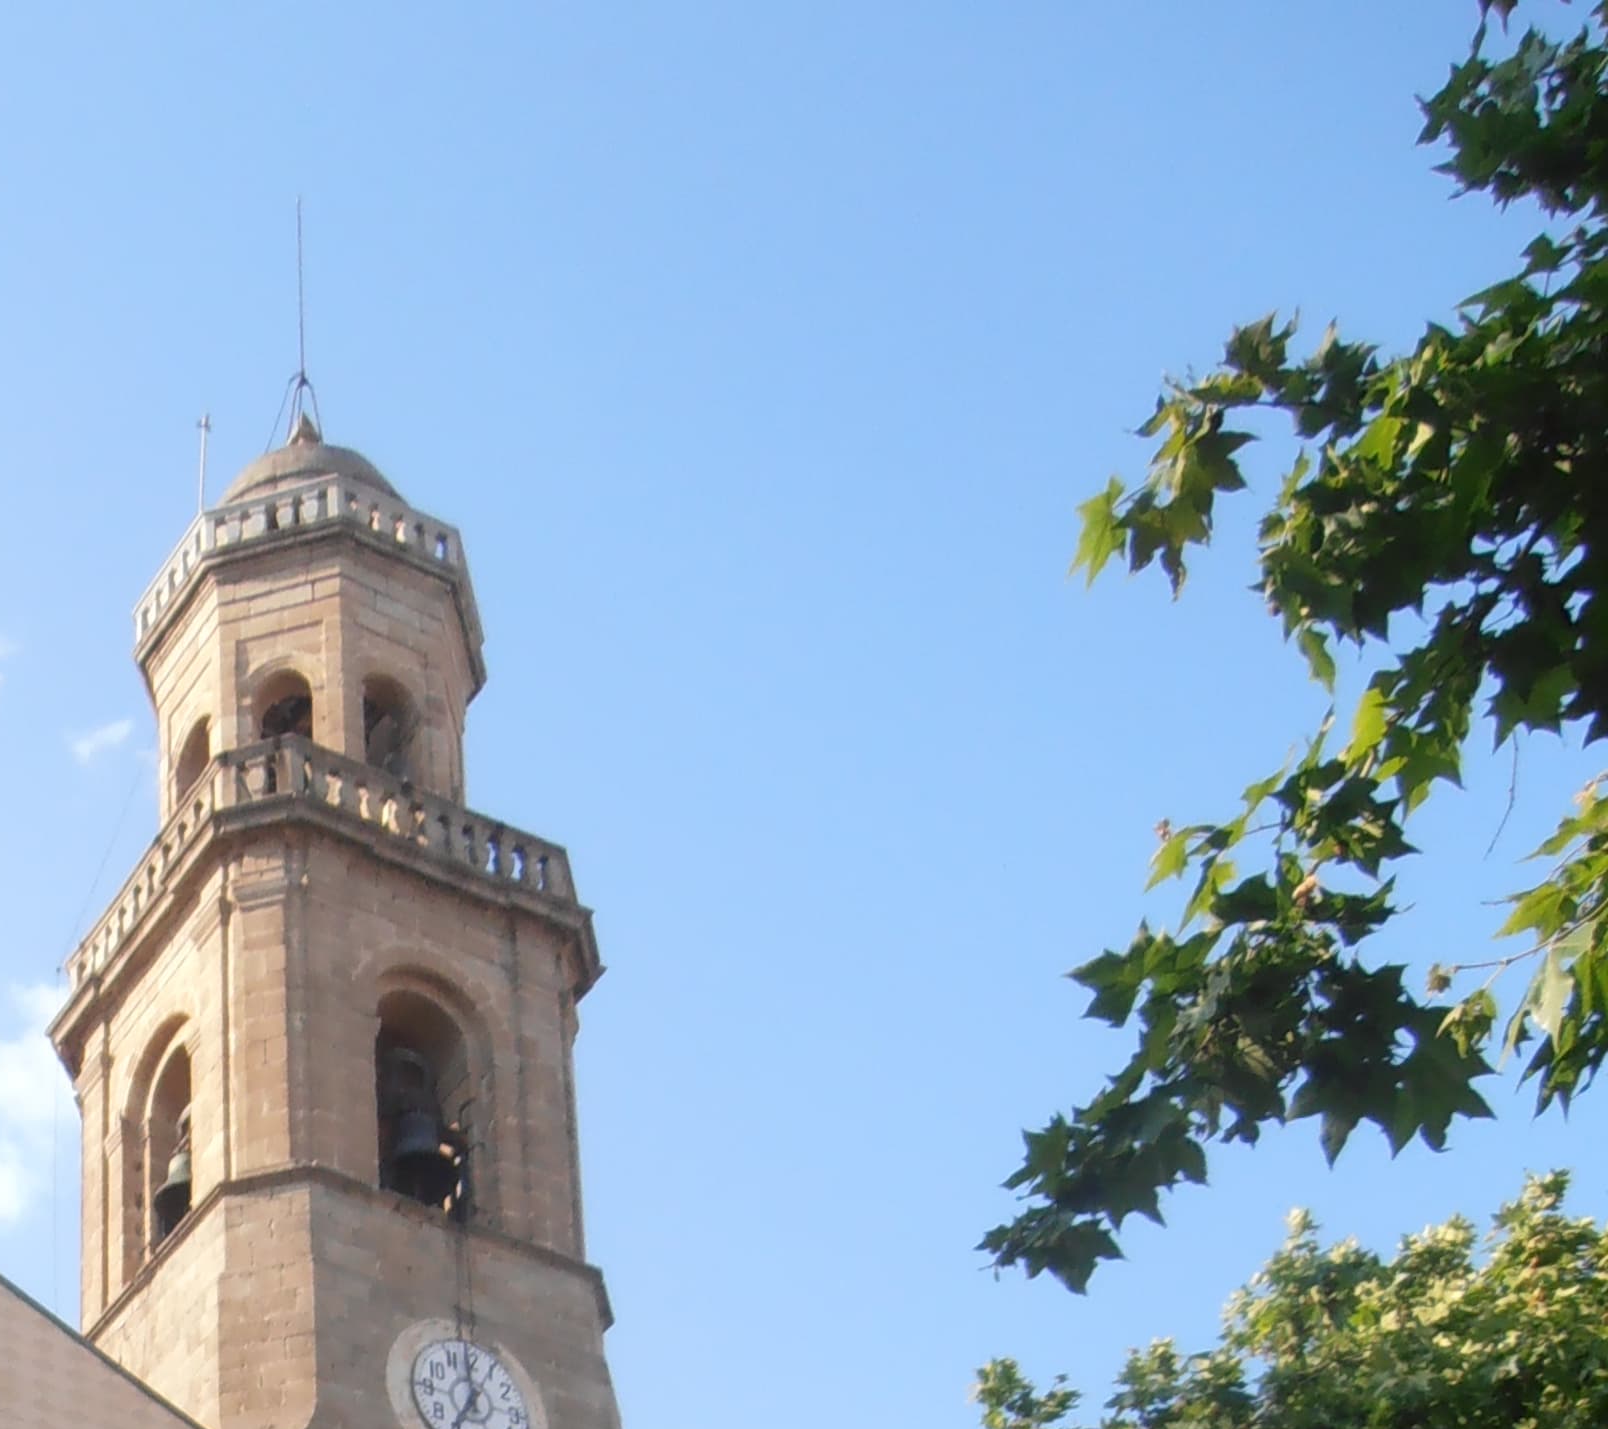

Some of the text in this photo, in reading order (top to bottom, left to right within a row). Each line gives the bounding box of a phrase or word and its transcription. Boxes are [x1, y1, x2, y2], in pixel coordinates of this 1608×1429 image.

[429, 1359, 445, 1381] 10
[422, 1377, 435, 1396] 9
[499, 1381, 512, 1401] 2
[432, 1401, 444, 1420] 8
[508, 1405, 520, 1425] 3
